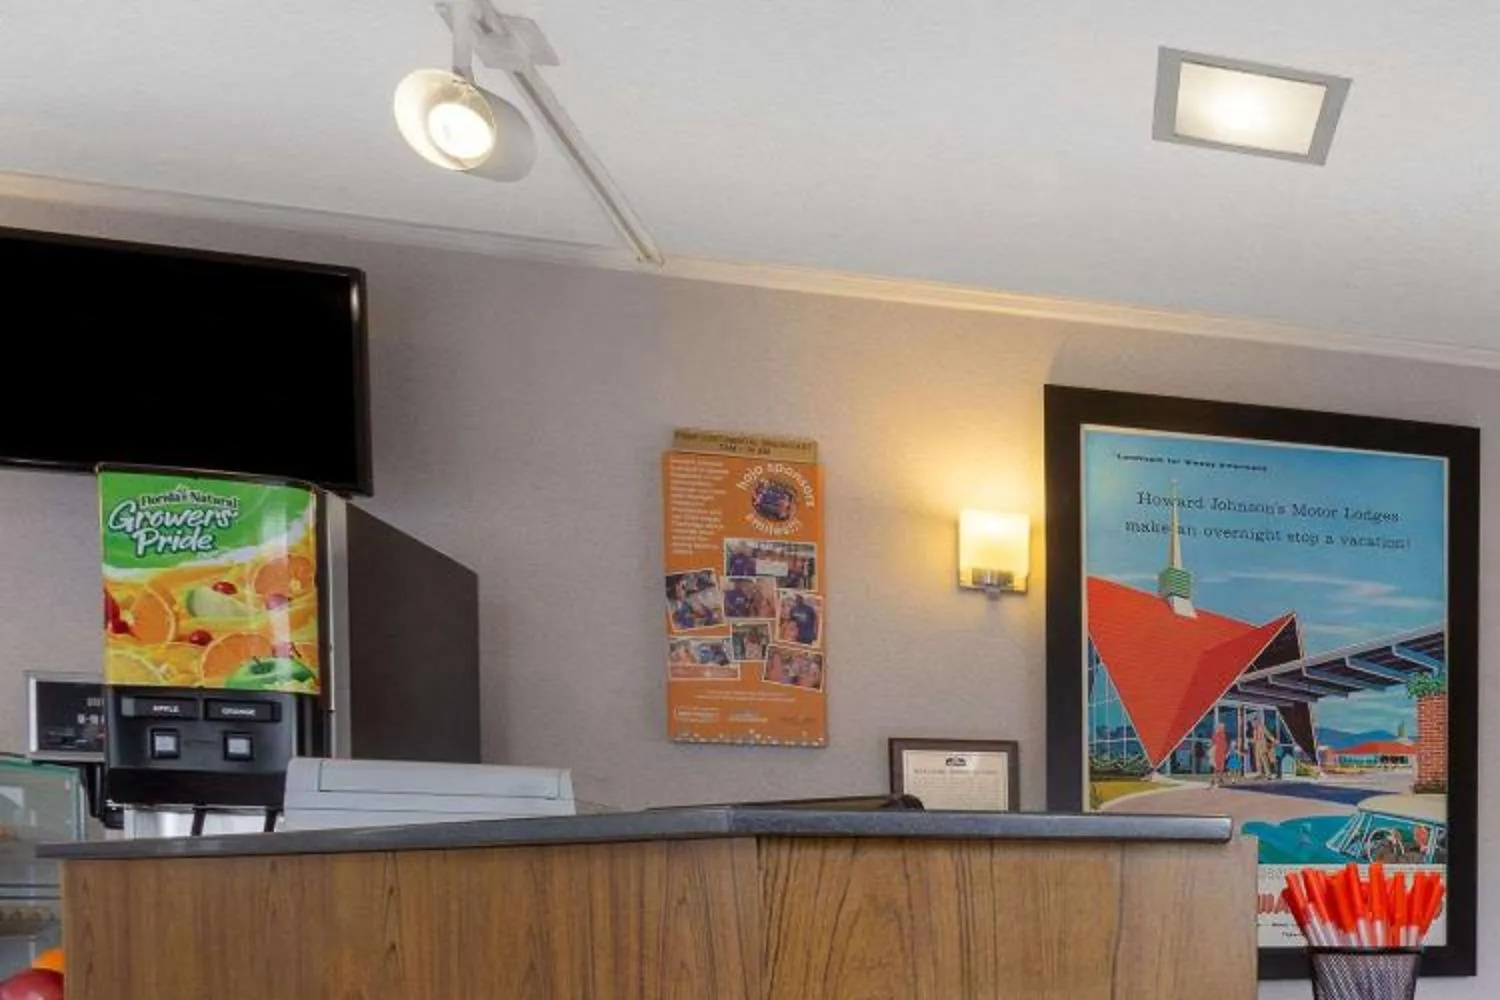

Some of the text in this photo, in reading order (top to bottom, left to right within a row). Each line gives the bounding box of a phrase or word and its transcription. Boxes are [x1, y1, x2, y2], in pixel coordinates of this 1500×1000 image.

[190, 490, 239, 509] Natural
[1136, 491, 1400, 525] Howard Johnson's Motor Lodges
[132, 527, 215, 556] Pride
[1124, 520, 1170, 534] make
[1178, 524, 1197, 536] an
[1203, 526, 1282, 543] overnight
[1287, 531, 1320, 547] stop
[1325, 536, 1335, 545] a
[152, 703, 180, 714] APPLE
